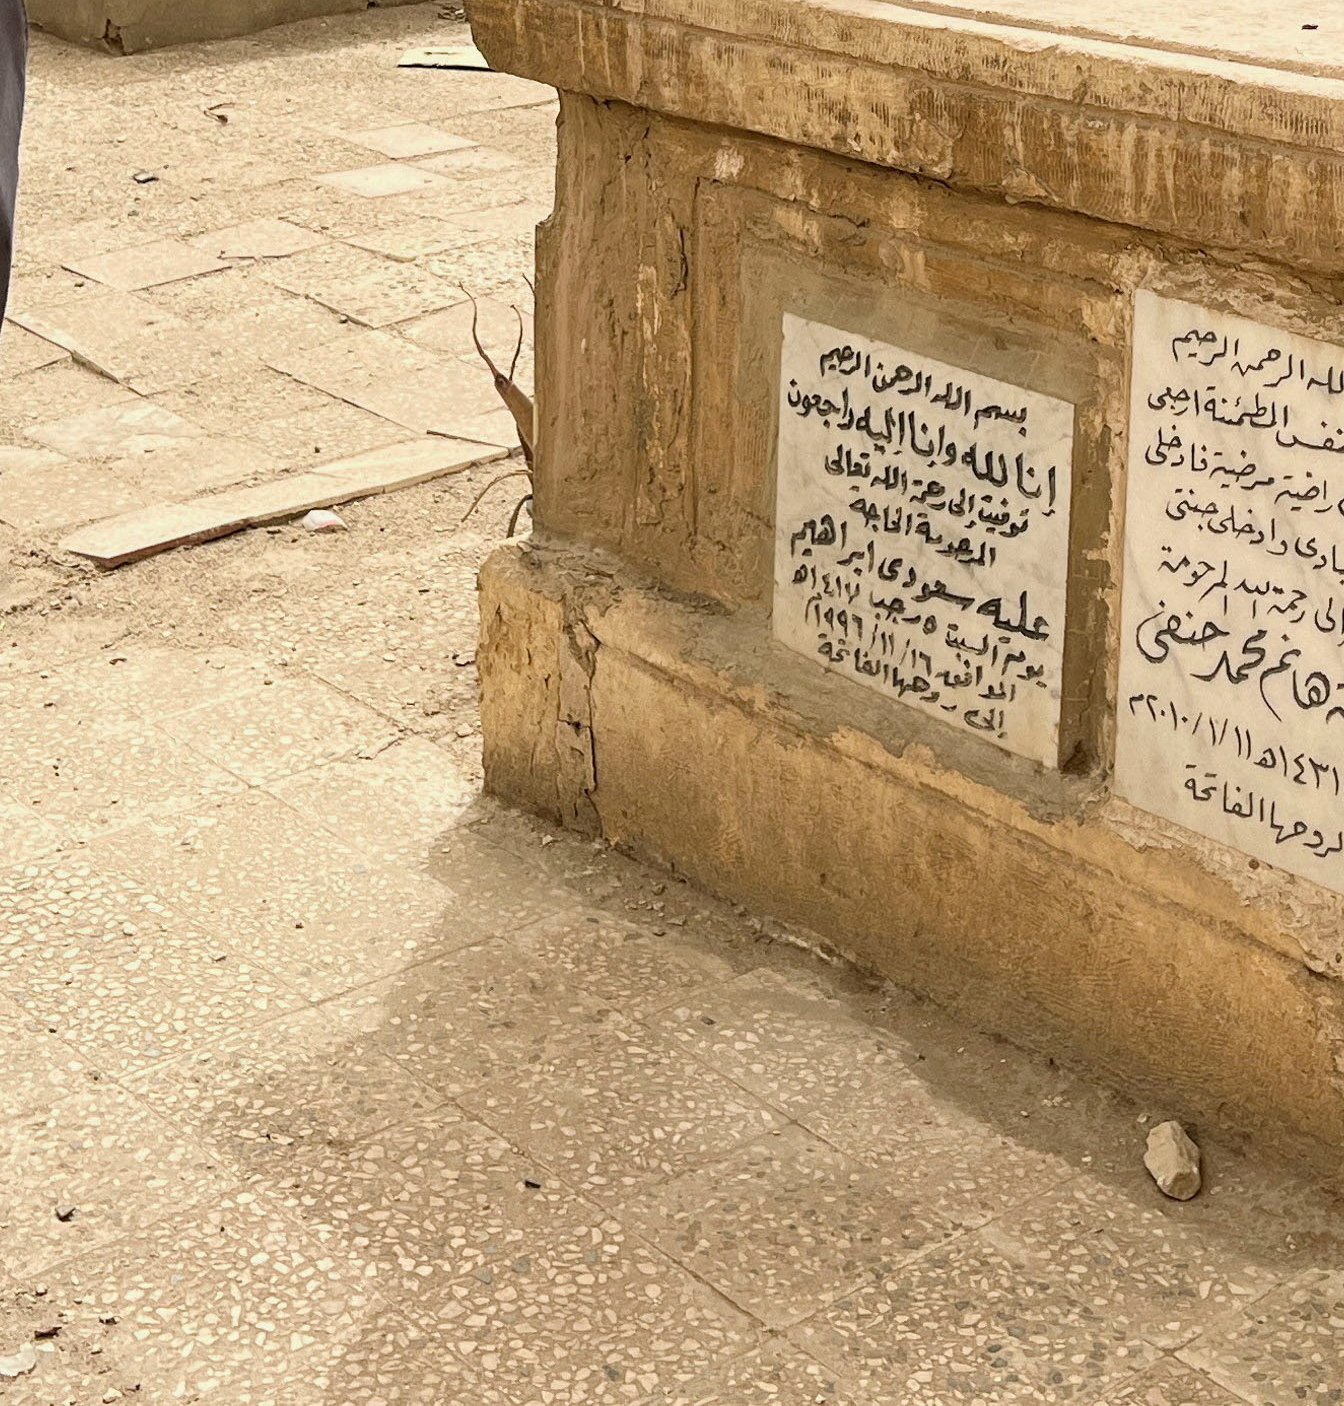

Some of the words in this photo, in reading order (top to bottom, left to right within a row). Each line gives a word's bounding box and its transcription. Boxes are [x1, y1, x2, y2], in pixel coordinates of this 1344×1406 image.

[819, 345, 870, 378] الرحيم
[1172, 329, 1240, 366] الرحيم
[1230, 348, 1305, 388] الرحمن
[871, 362, 933, 398] الرحمن
[930, 382, 972, 416] الله
[787, 378, 855, 430] راجعون
[973, 404, 1028, 437] بسم
[1203, 384, 1289, 430] المطمئنة
[824, 443, 872, 478] تعالى
[870, 465, 908, 495] الله
[961, 442, 1008, 488] لله
[1208, 449, 1276, 491] مرضية
[1274, 471, 1334, 513] راضية
[977, 494, 1030, 539] توفيت
[1157, 545, 1230, 616] المرحومة
[1233, 577, 1271, 620] الله
[869, 591, 922, 624] رجب
[1266, 586, 1308, 623] رحمة
[818, 633, 890, 684] الفاتحة
[945, 623, 998, 667] السبت
[1189, 629, 1268, 685] محمد
[1259, 634, 1332, 722] هانم
[1184, 764, 1265, 823] الفاتحة
[1270, 801, 1344, 858] لروحها
